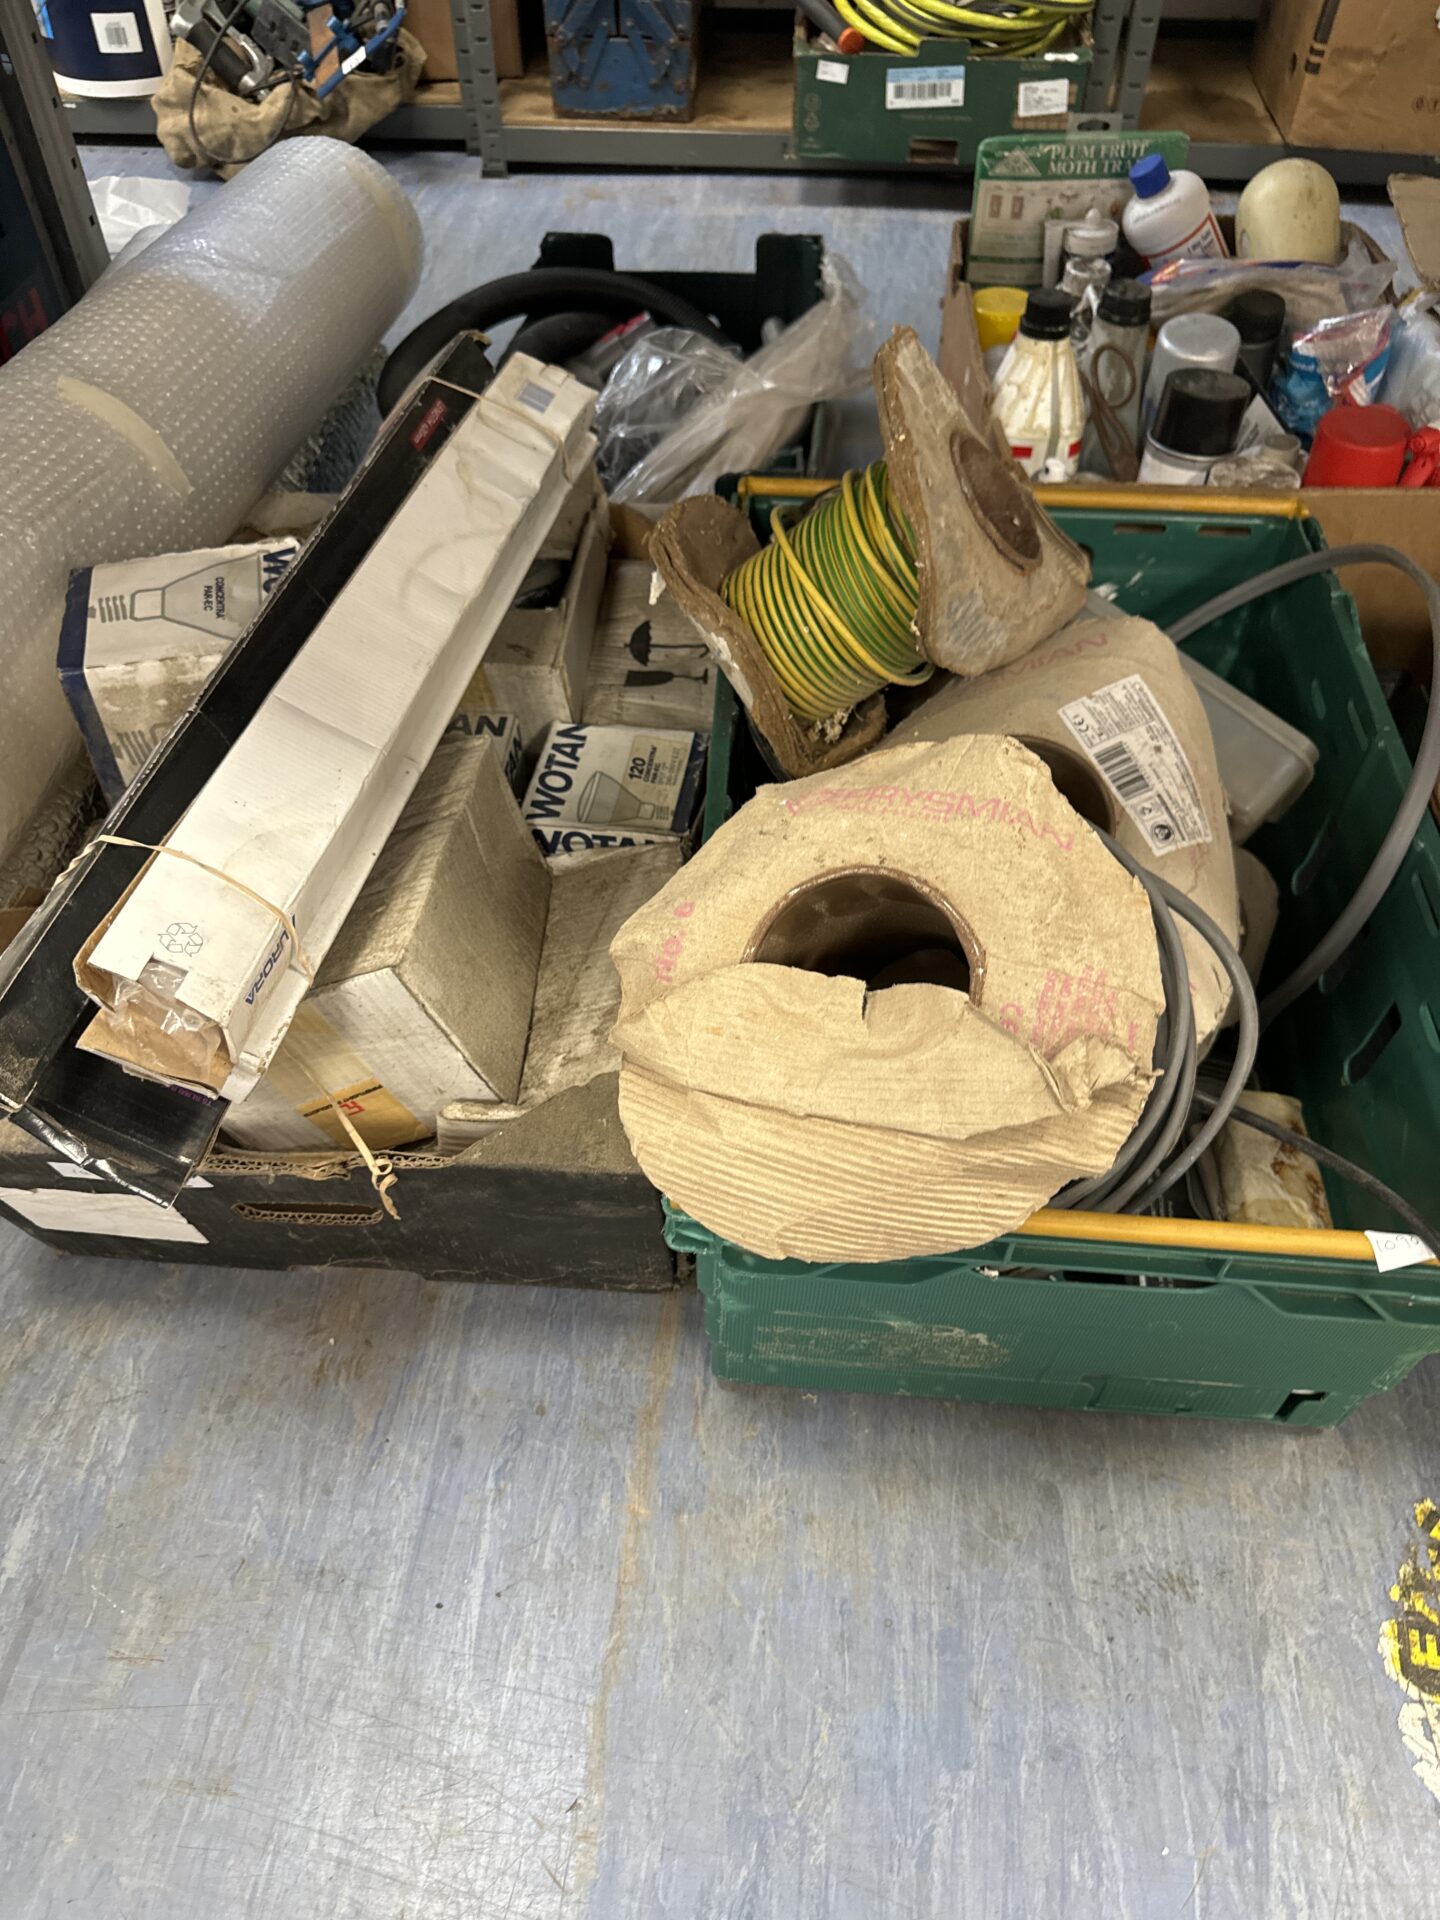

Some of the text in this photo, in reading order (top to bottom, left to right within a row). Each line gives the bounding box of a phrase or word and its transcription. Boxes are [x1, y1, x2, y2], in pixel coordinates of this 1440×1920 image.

[1051, 140, 1150, 161] PLUM FRUIT
[1048, 159, 1136, 176] MOTH TRA
[526, 724, 592, 820] WOTAN
[628, 757, 646, 780] 120
[245, 914, 296, 1005] URORA
